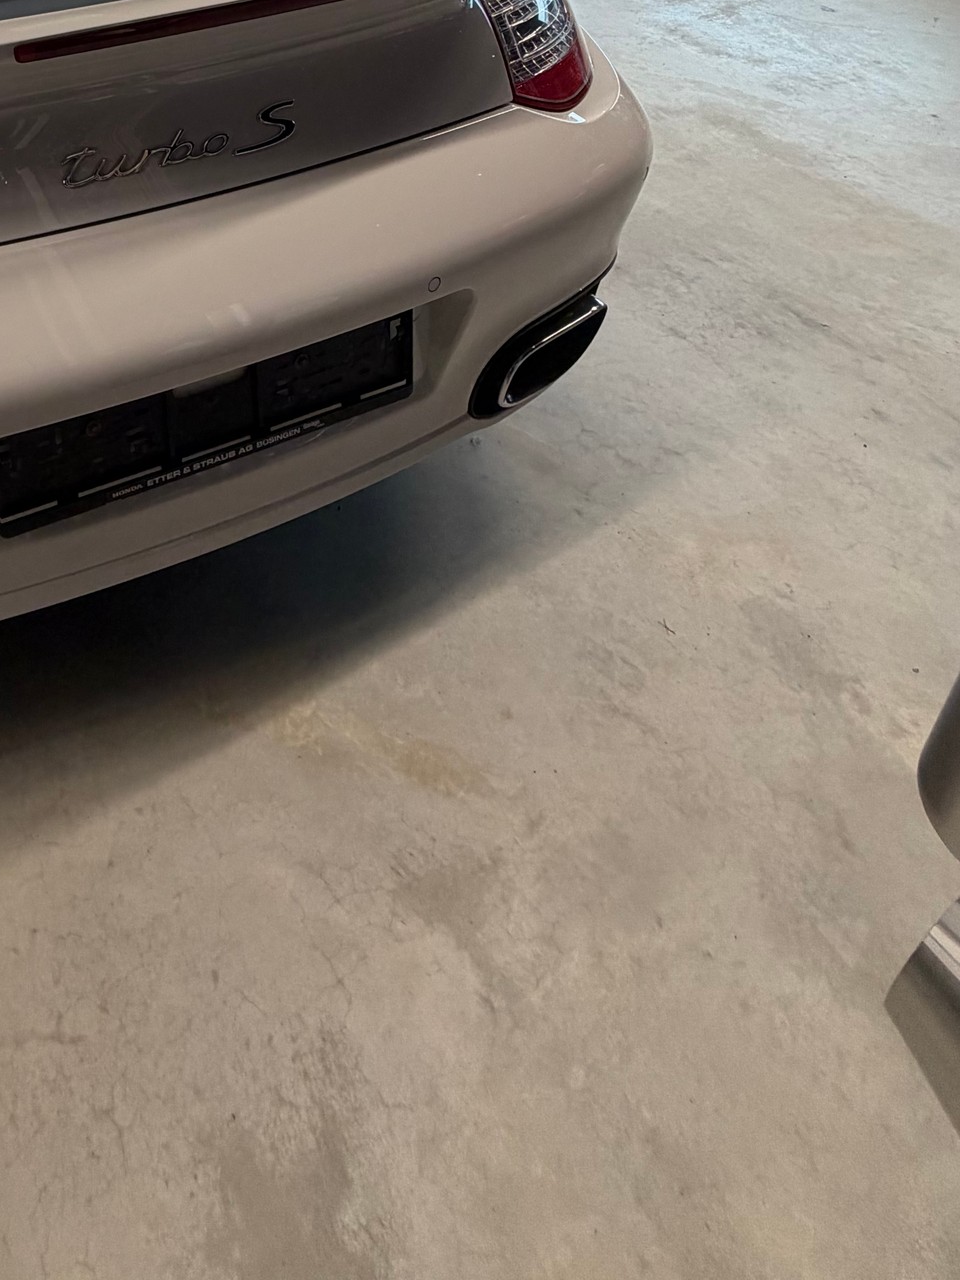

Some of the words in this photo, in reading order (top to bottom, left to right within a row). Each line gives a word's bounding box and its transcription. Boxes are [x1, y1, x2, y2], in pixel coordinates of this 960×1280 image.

[61, 129, 229, 188] turbo
[232, 99, 296, 156] S
[112, 484, 143, 498] HONDA
[147, 470, 181, 486] ETTER
[183, 466, 191, 475] &
[193, 450, 236, 470] STRAUB
[238, 444, 253, 455] AG
